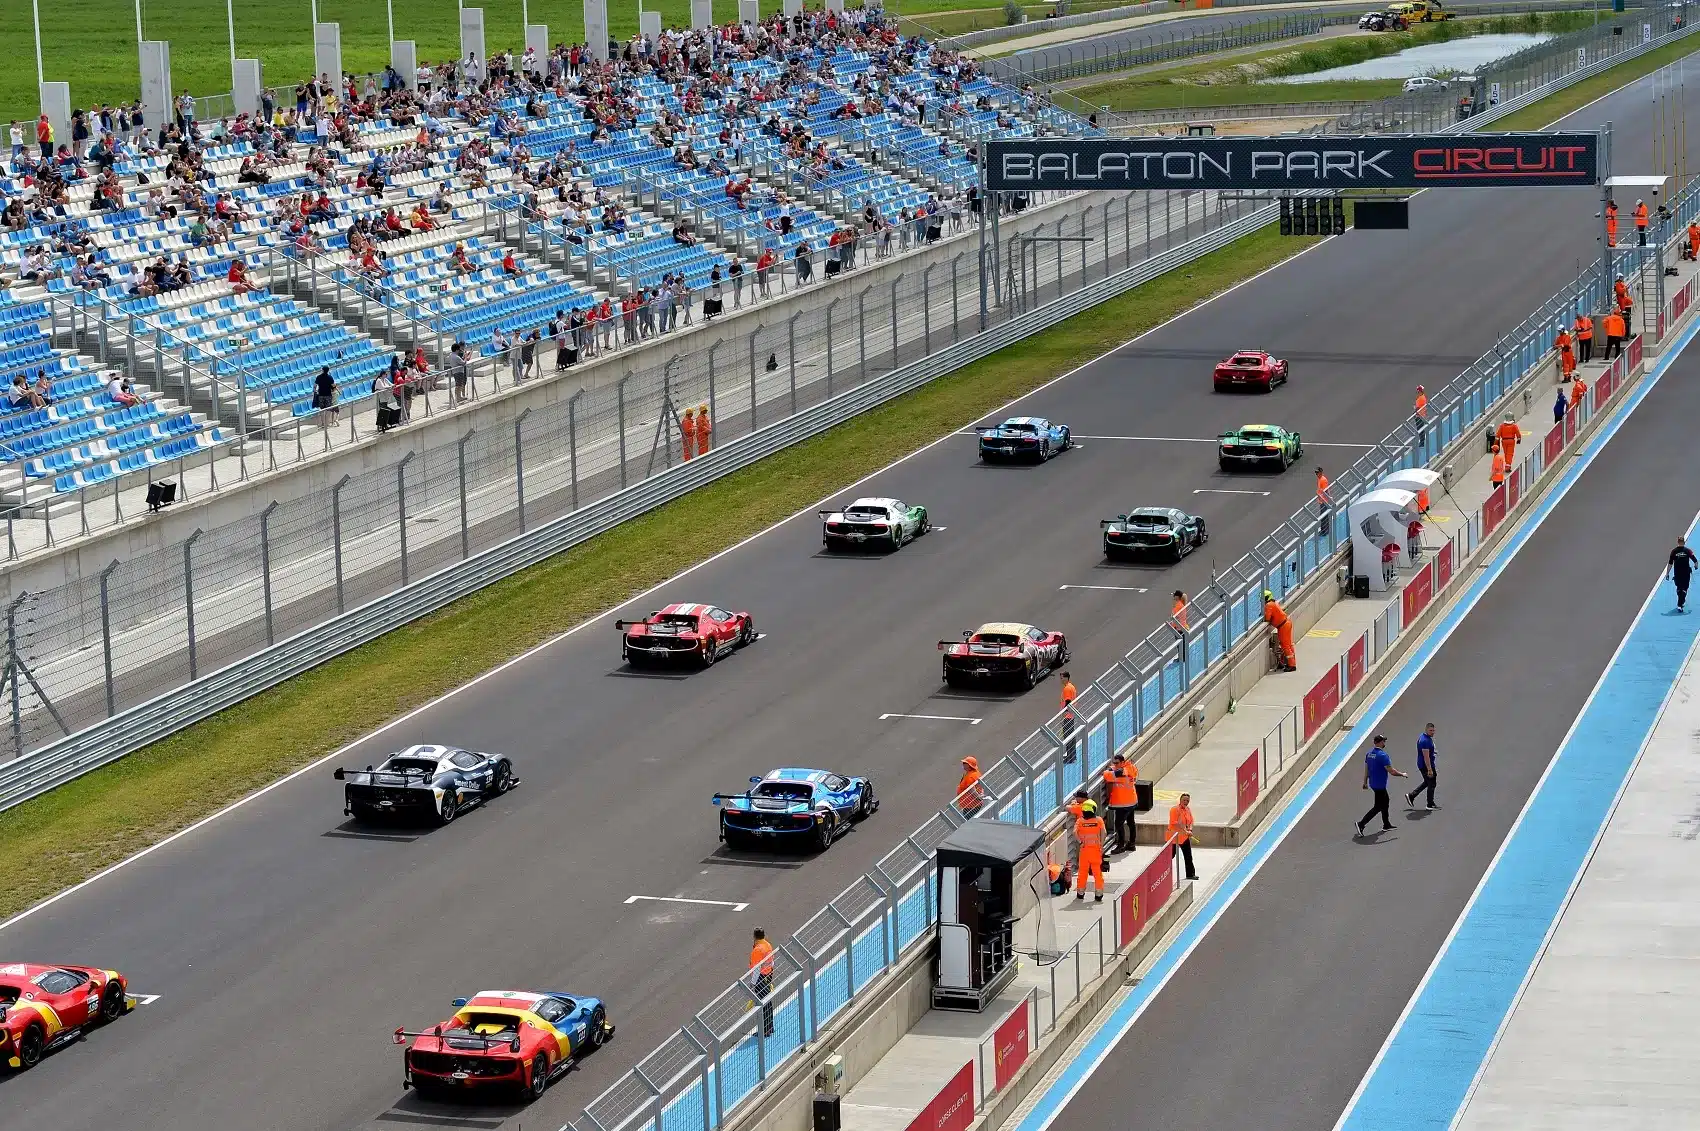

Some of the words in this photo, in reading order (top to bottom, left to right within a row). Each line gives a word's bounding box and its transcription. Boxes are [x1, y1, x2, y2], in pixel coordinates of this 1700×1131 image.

[1002, 151, 1232, 180] BALATON
[1252, 150, 1394, 179] PARK
[1413, 146, 1586, 171] CIRCUIT
